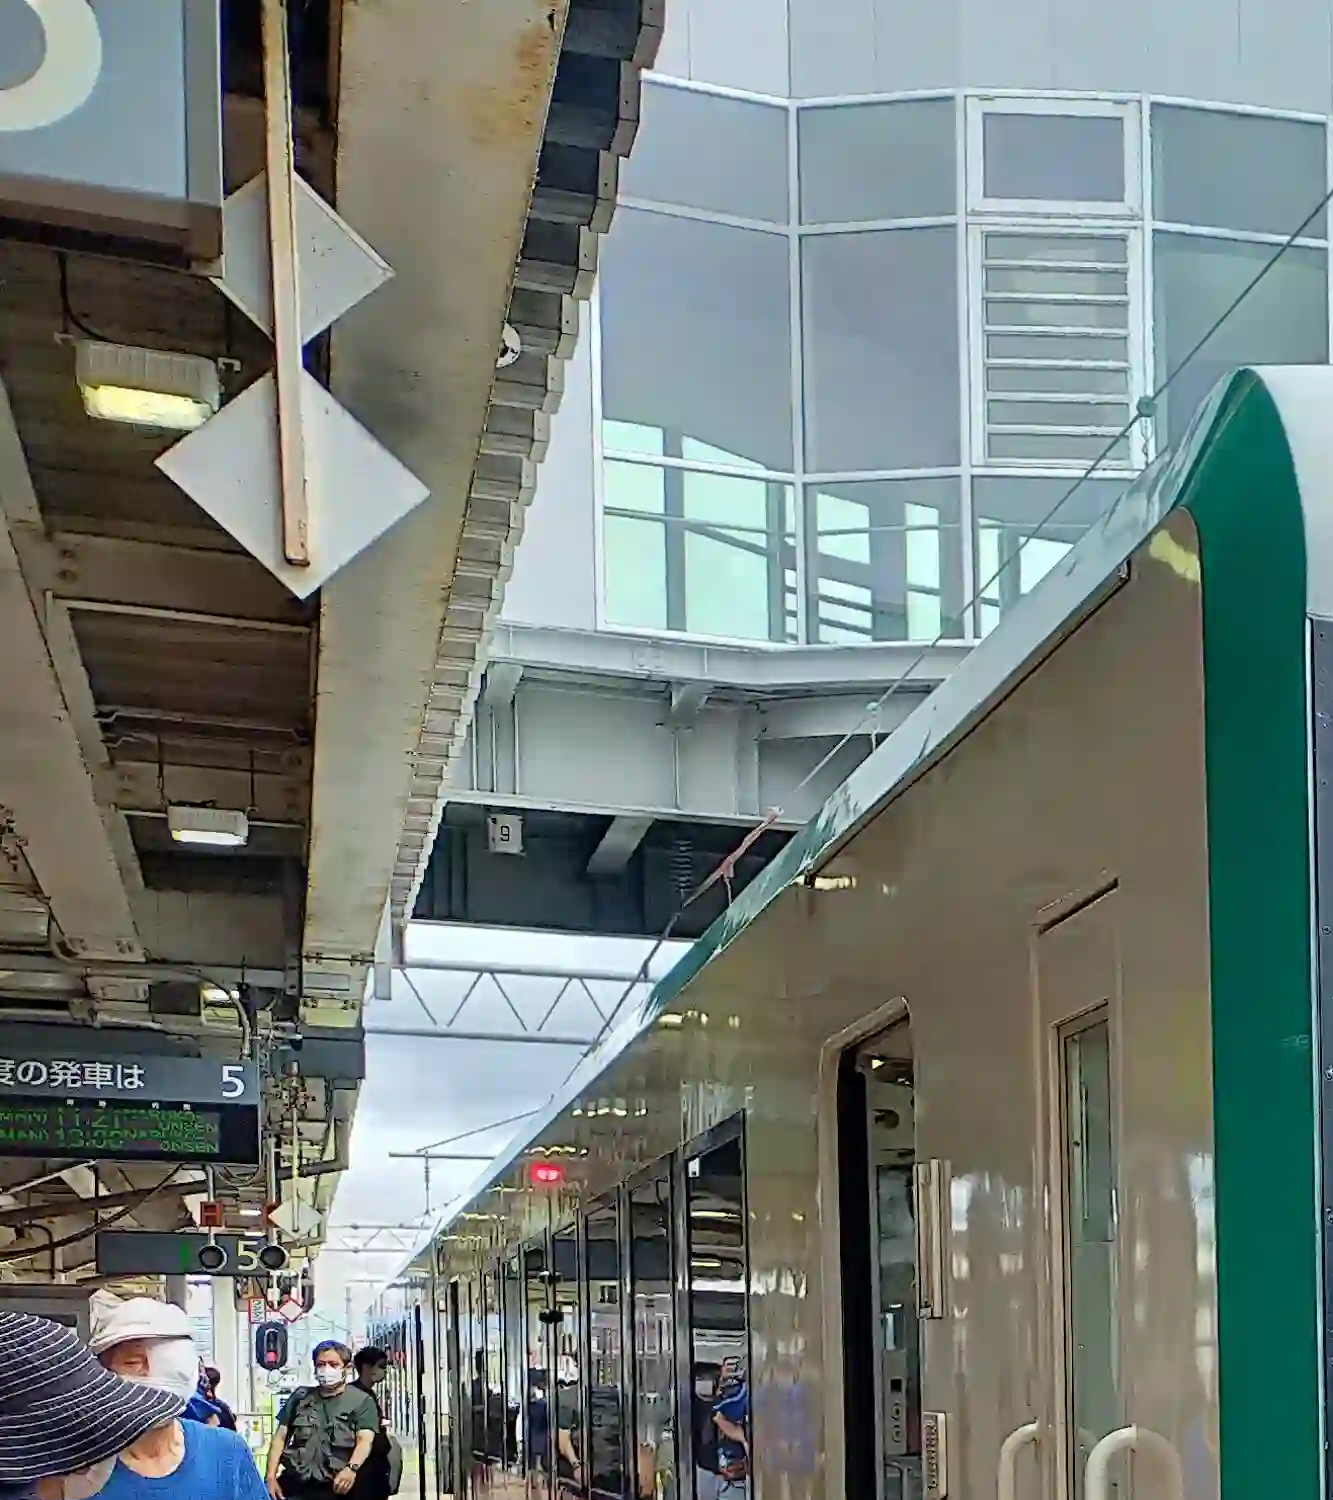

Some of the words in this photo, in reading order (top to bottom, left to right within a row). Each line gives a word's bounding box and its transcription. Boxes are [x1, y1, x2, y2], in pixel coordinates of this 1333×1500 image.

[499, 824, 511, 843] 9
[221, 1065, 246, 1098] 5
[237, 1239, 260, 1271] 5
